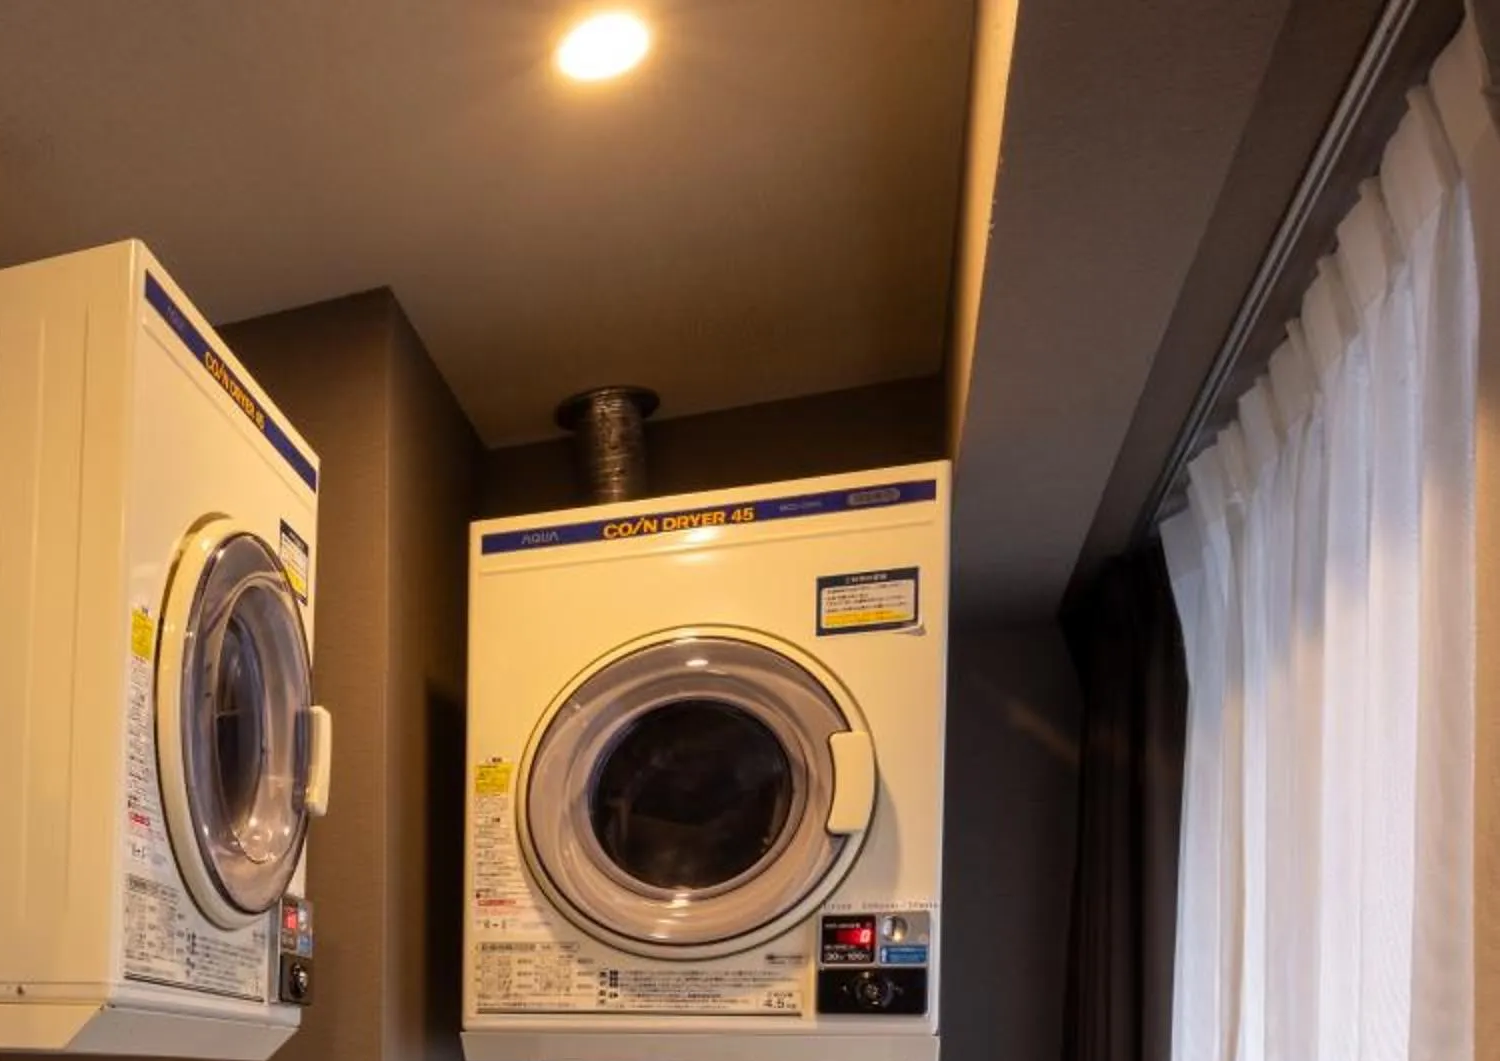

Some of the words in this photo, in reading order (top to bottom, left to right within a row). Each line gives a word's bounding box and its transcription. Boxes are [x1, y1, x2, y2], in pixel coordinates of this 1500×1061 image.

[603, 516, 658, 539] COIN
[663, 511, 726, 533] DRYER
[731, 507, 755, 524] 45
[521, 531, 559, 545] AQUA
